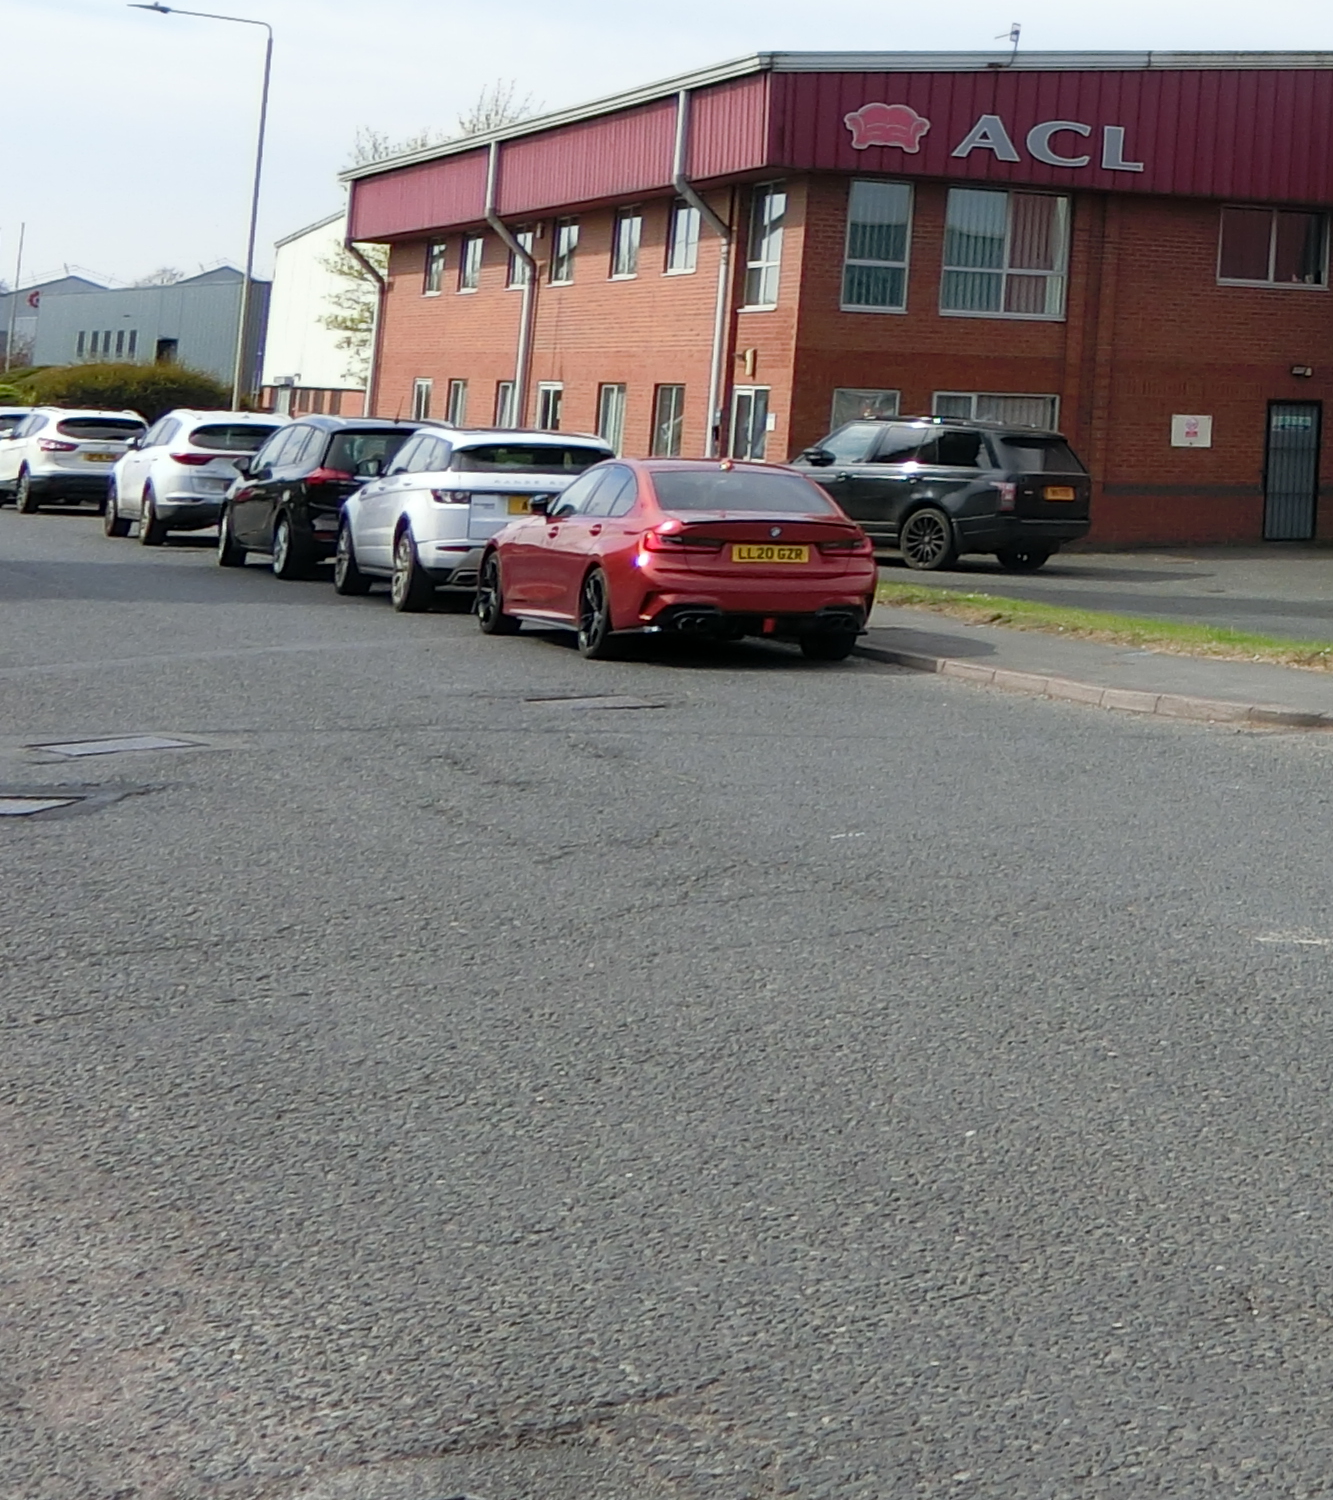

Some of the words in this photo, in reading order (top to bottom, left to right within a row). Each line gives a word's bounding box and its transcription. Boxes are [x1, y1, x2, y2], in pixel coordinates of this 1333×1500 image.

[951, 114, 1145, 173] ACL
[738, 546, 775, 560] LL20
[777, 547, 804, 560] GZR
